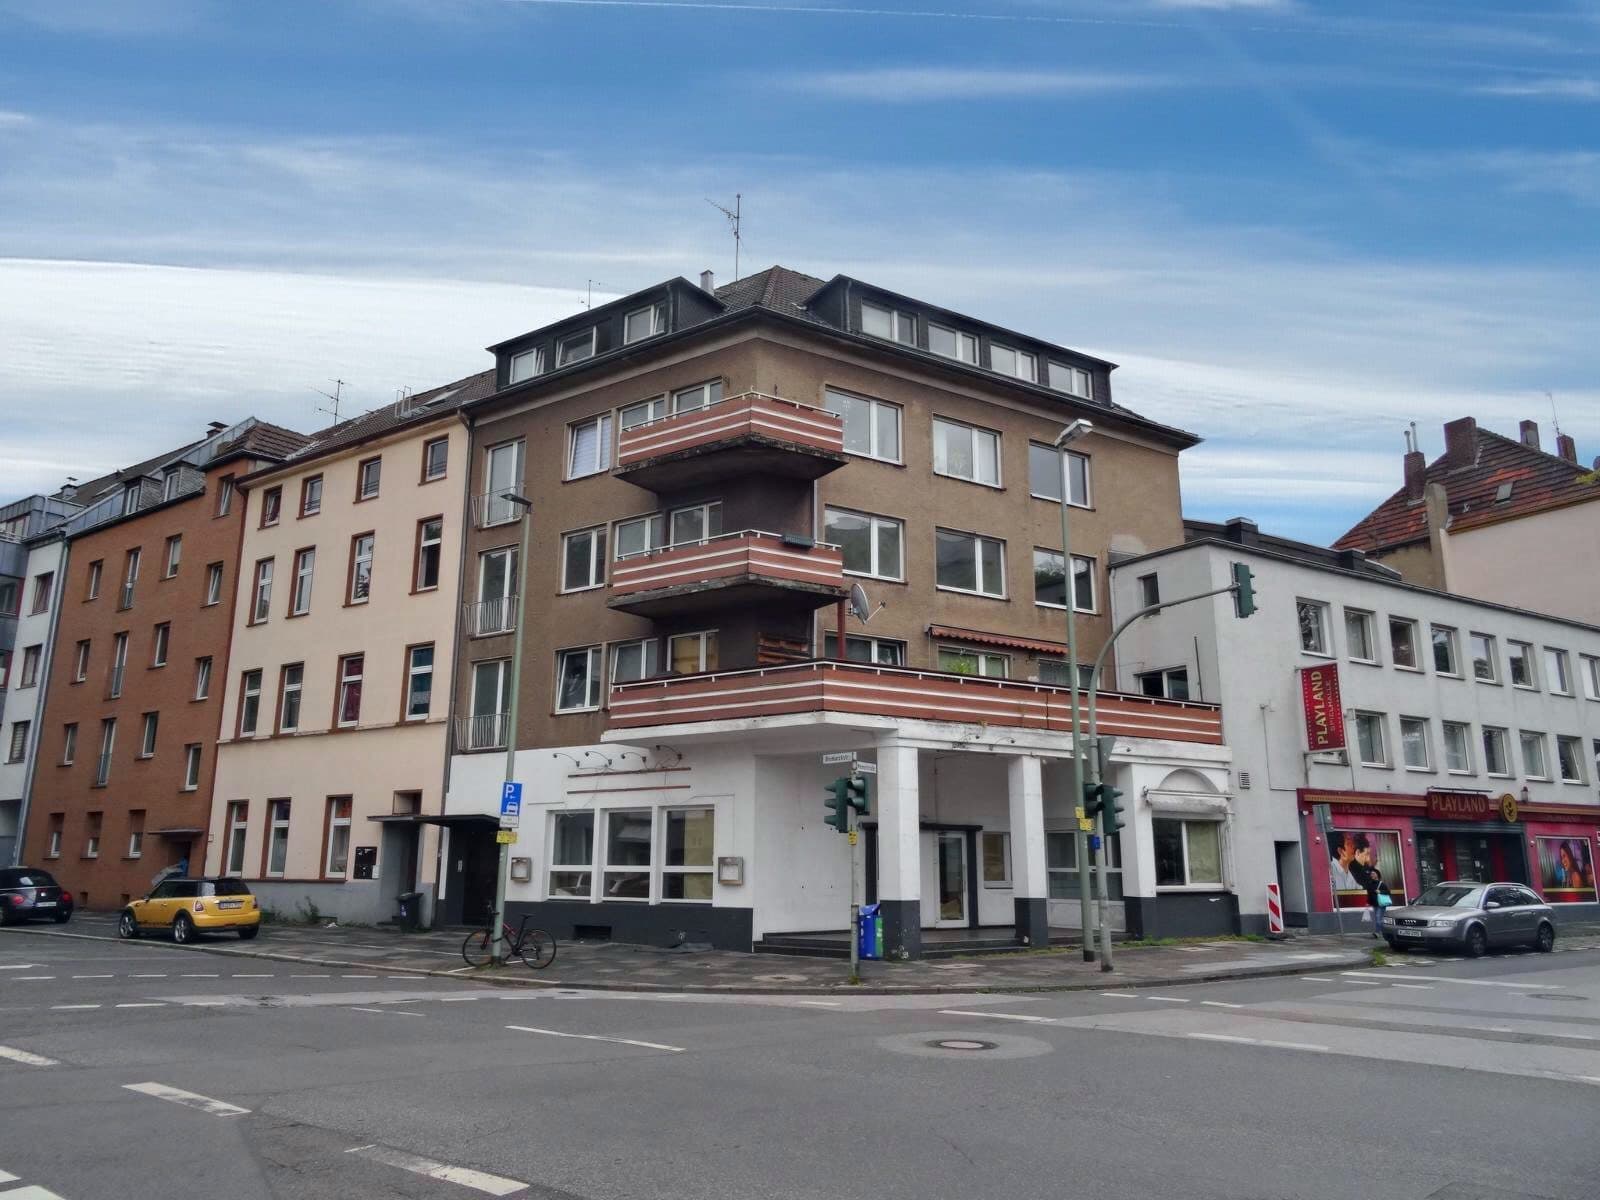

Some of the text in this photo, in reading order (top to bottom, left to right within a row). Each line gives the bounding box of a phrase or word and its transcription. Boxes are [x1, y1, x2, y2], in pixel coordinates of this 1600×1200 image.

[1311, 671, 1329, 745] PLAYLAND
[505, 784, 515, 798] P
[1431, 794, 1486, 813] PLAYLAND
